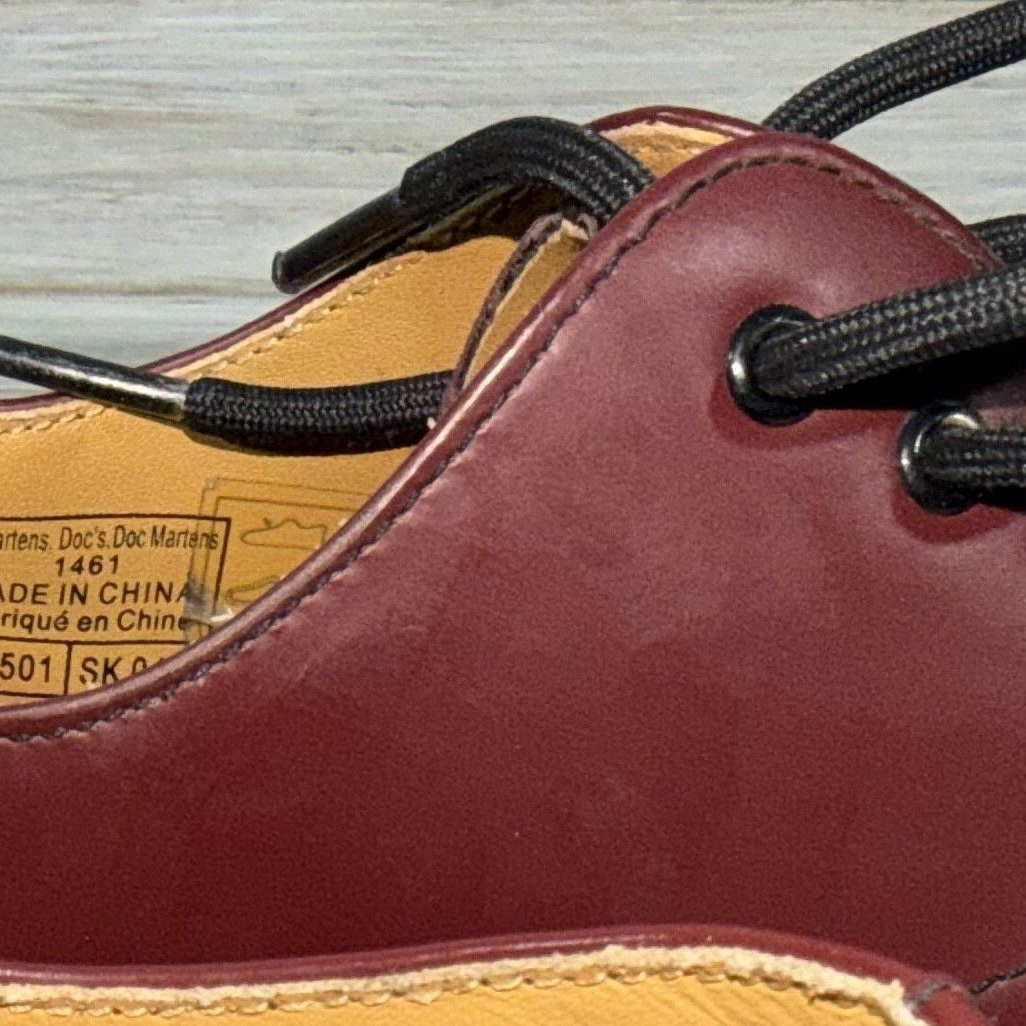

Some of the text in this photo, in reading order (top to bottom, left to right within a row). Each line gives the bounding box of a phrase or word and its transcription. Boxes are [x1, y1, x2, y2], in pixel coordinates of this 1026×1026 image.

[150, 525, 219, 550] Martens
[55, 554, 119, 577] 1461
[59, 583, 88, 605] IN
[77, 613, 108, 632] en
[80, 656, 123, 685] SK
